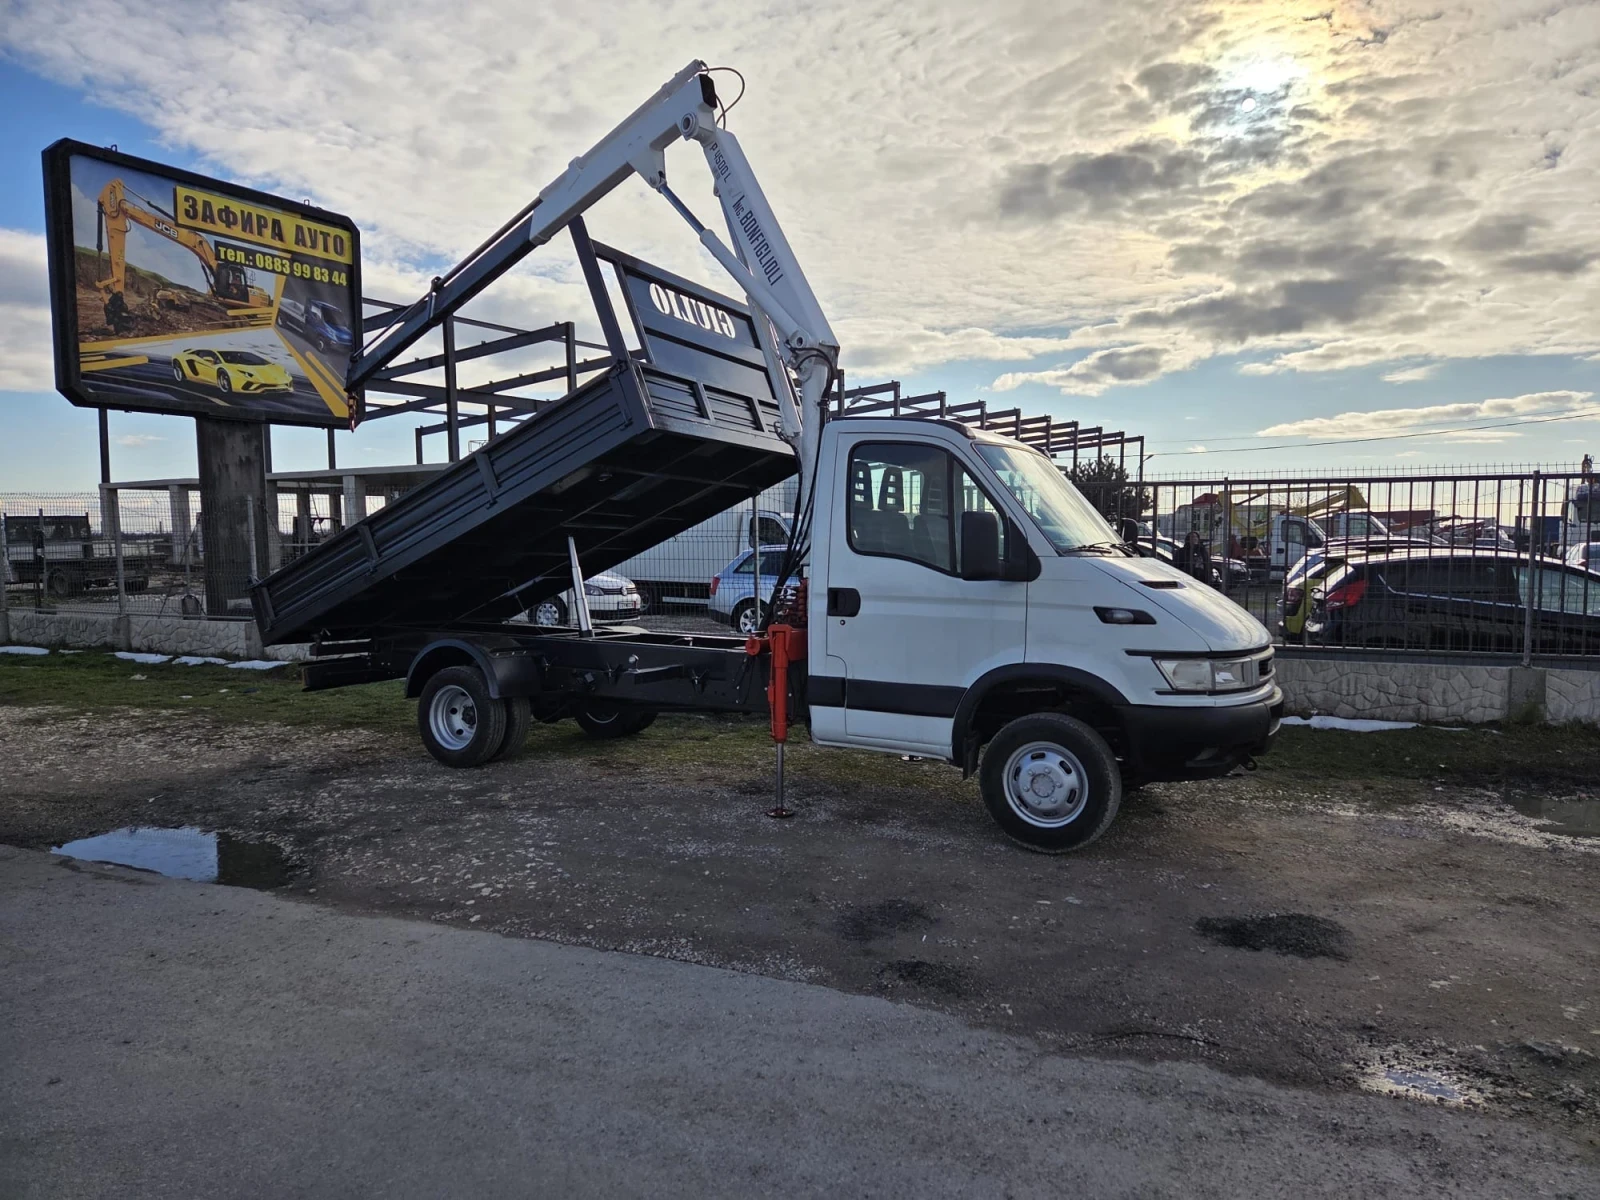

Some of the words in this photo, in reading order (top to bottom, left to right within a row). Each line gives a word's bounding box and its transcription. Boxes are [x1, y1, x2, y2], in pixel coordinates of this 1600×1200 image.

[709, 142, 718, 152] P
[713, 150, 729, 176] 4500
[723, 172, 731, 183] L
[155, 220, 178, 238] JCB
[183, 194, 285, 243] ЗАФИРА
[294, 223, 345, 257] АУТО
[740, 210, 784, 286] BONFIGLIOLI
[218, 246, 253, 266] тел.:
[255, 253, 291, 275] 0883
[293, 262, 311, 279] 99
[313, 266, 329, 283] 83
[331, 270, 347, 286] 44
